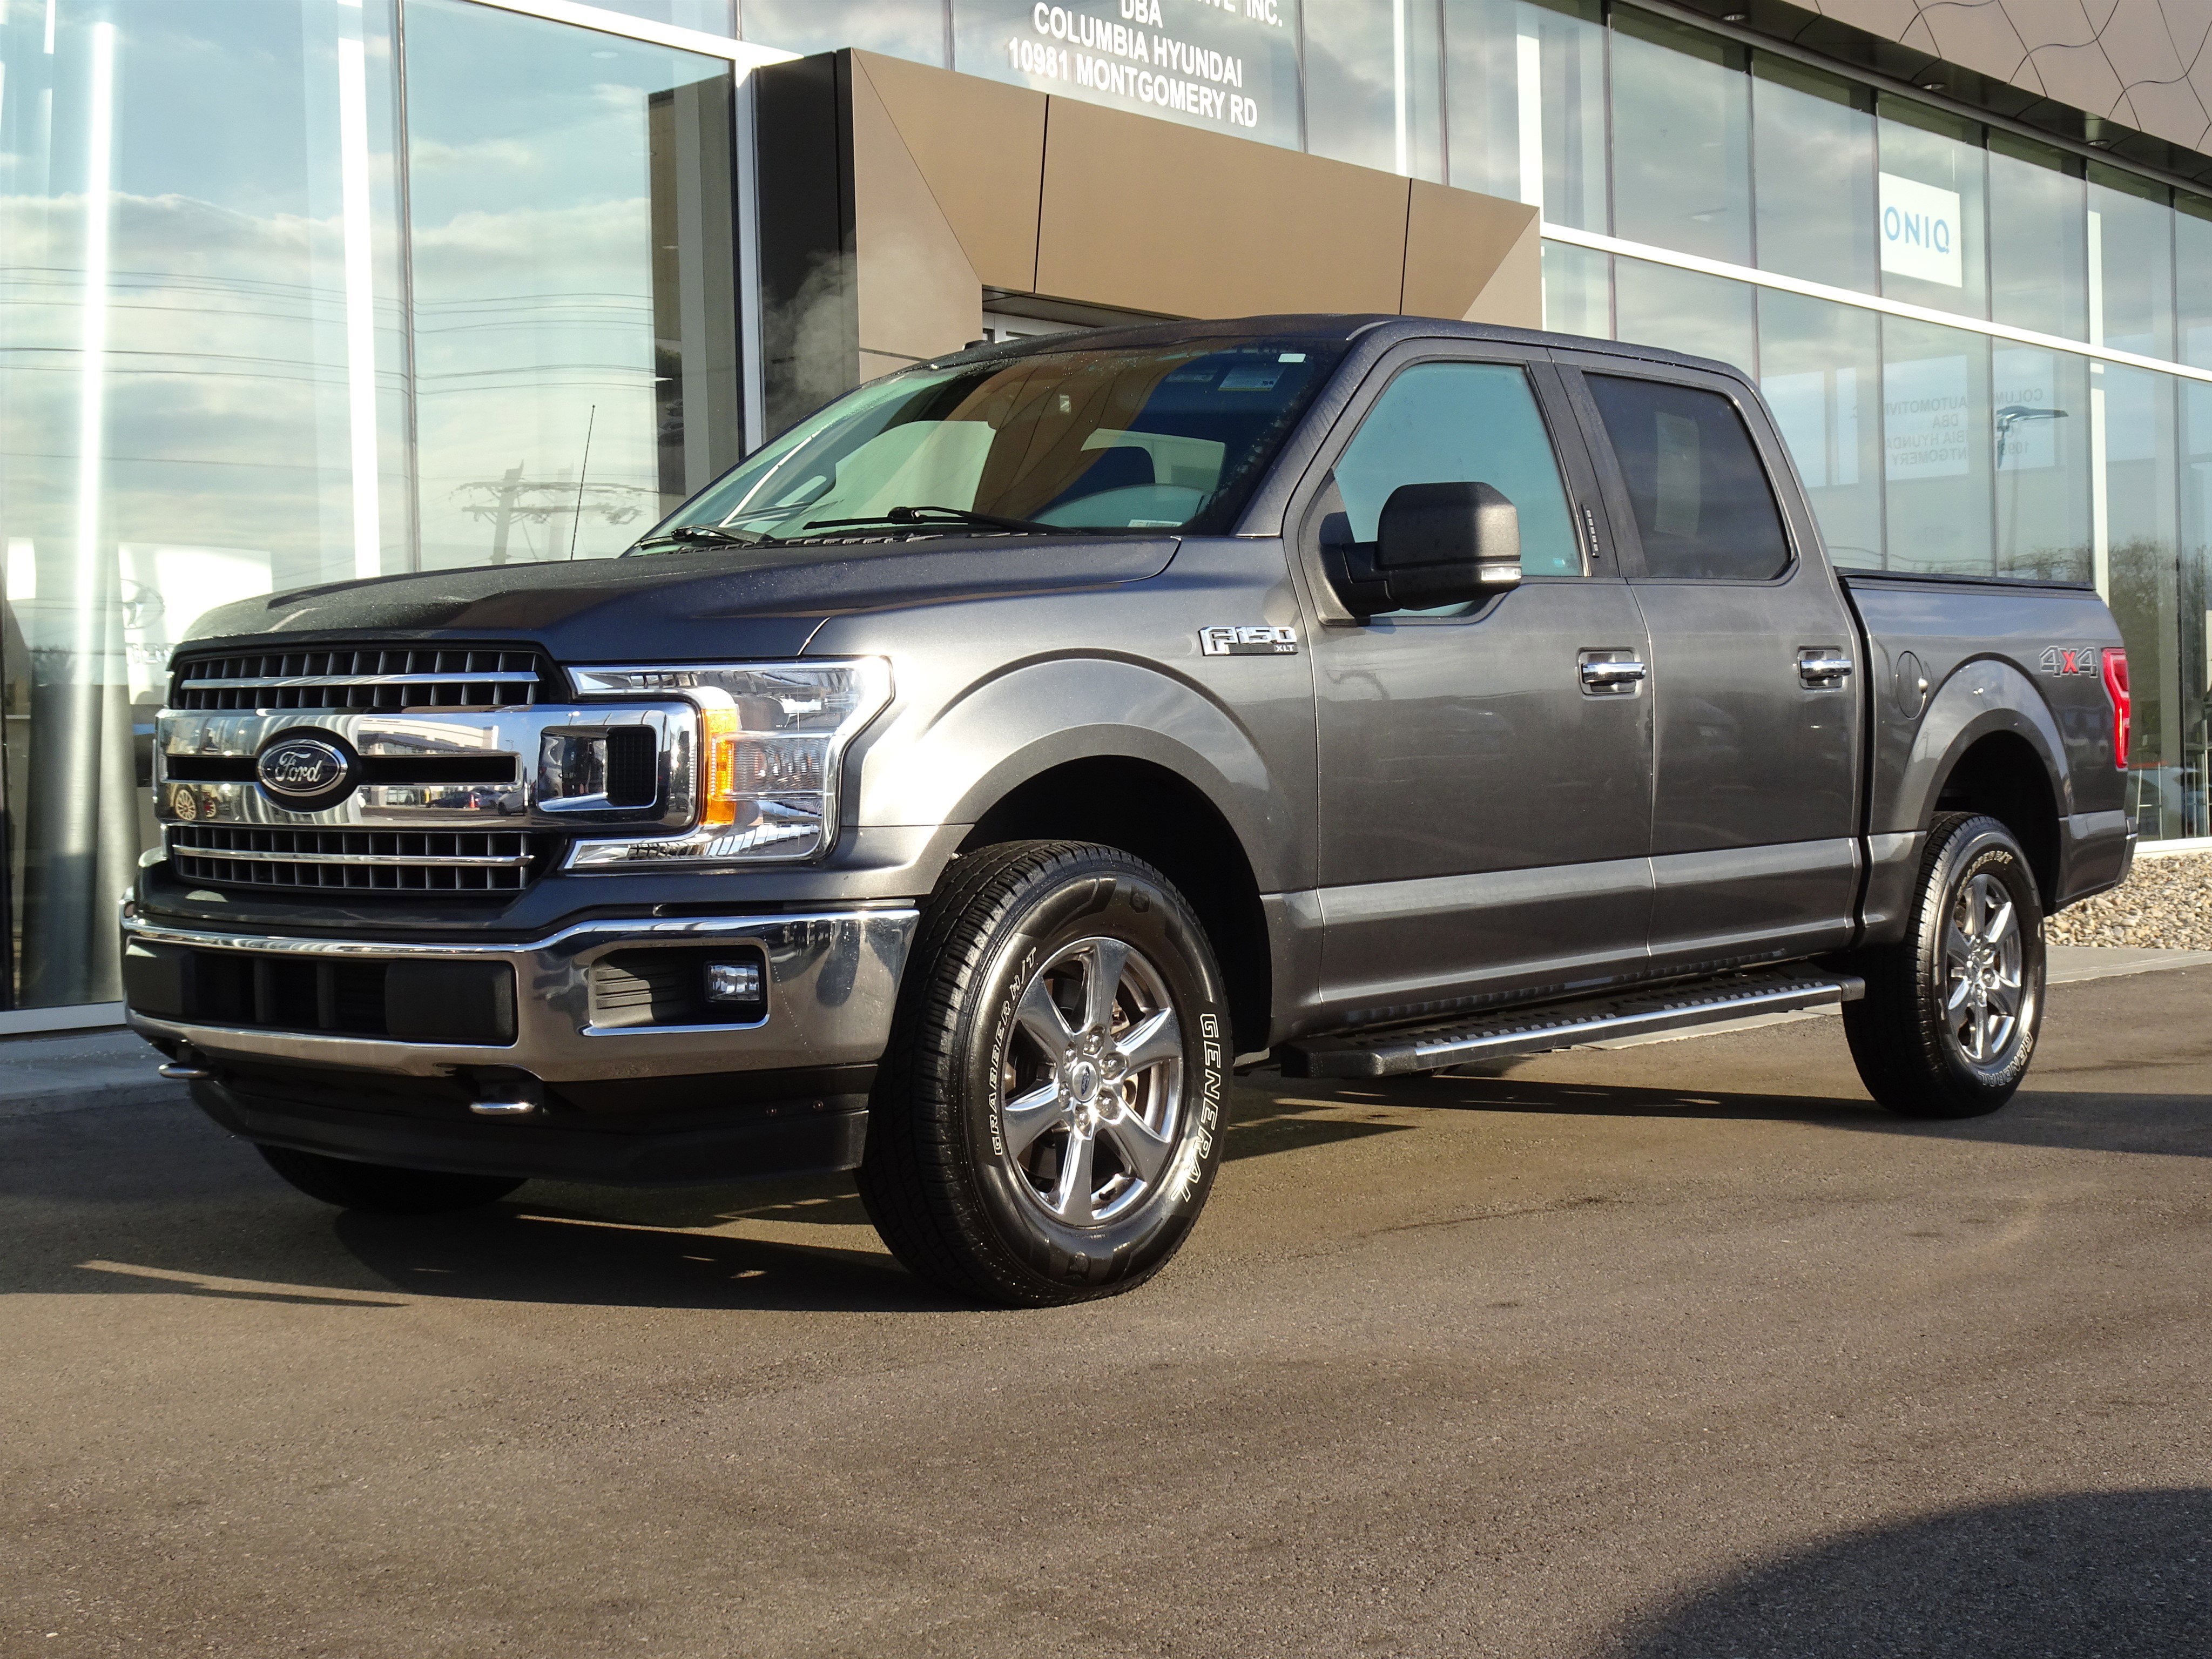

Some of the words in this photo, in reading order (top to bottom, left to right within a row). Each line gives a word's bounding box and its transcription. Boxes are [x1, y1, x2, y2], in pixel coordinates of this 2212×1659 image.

[1034, 2, 1149, 64] COLUMBIA
[1154, 35, 1243, 88] HYUNDAI
[1121, 0, 1163, 28] DBA
[1009, 37, 1068, 81] 10981
[1076, 52, 1225, 119] MONTGOMERY
[1230, 94, 1258, 128] RD
[1884, 206, 1950, 254] ONIQ
[274, 751, 323, 783] Ford
[988, 1000, 1010, 1156] GRABBER
[1009, 946, 1036, 1001] H/T
[1977, 1030, 2034, 1087] GENERAL
[1170, 1013, 1222, 1203] GENERAL
